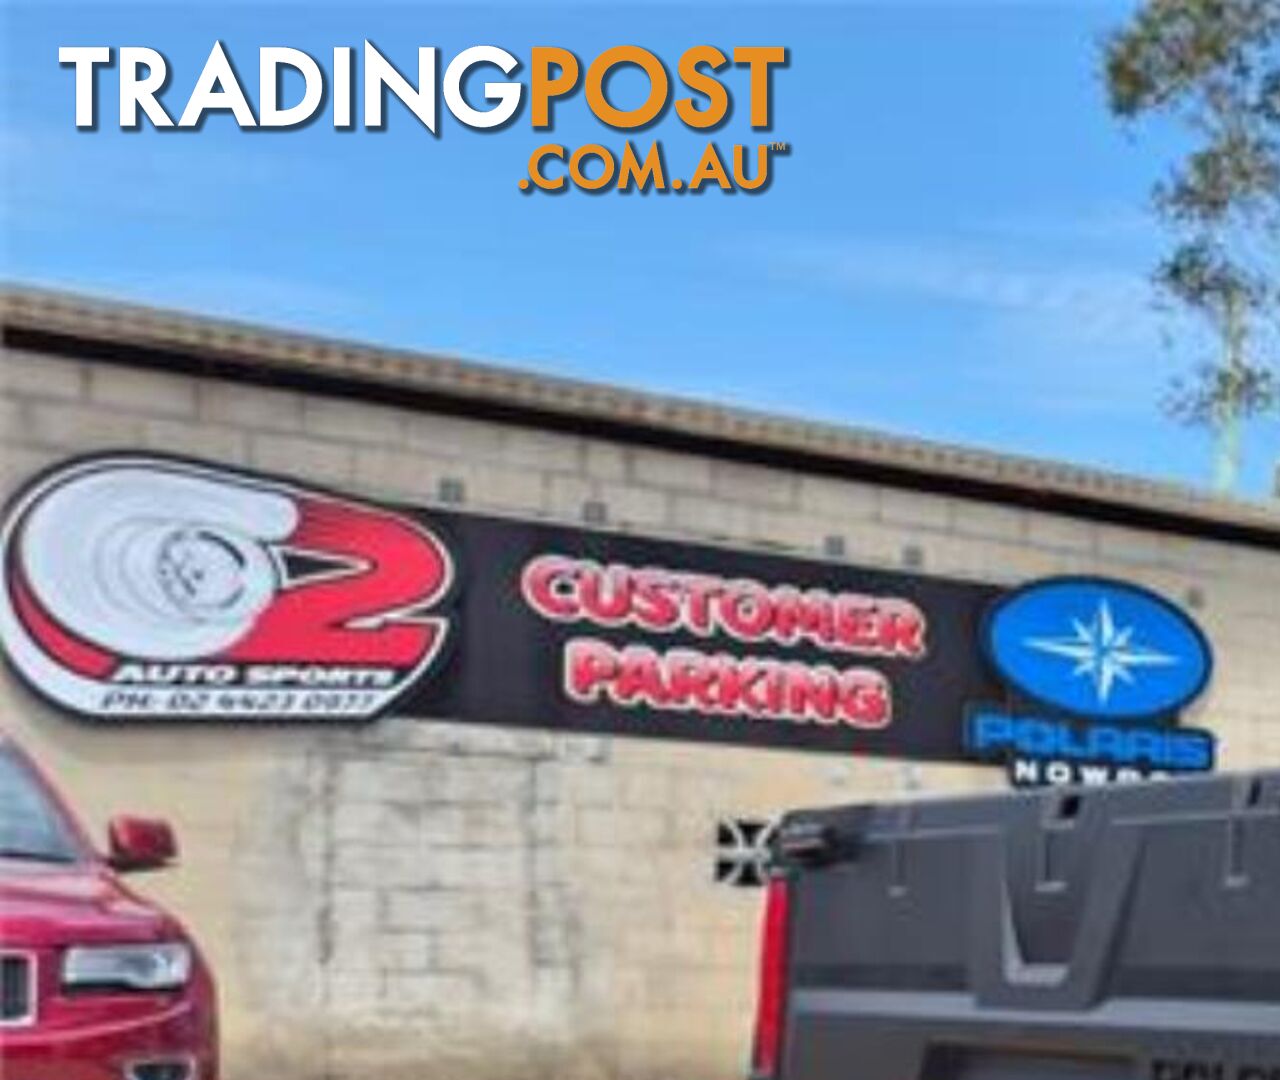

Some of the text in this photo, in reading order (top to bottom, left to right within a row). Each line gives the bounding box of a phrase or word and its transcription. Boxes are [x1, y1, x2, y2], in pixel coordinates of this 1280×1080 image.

[522, 555, 926, 658] CUSTOMER
[112, 664, 396, 687] AUTO SPORTS
[564, 638, 892, 728] PARKING
[974, 711, 1207, 769] POLARIS
